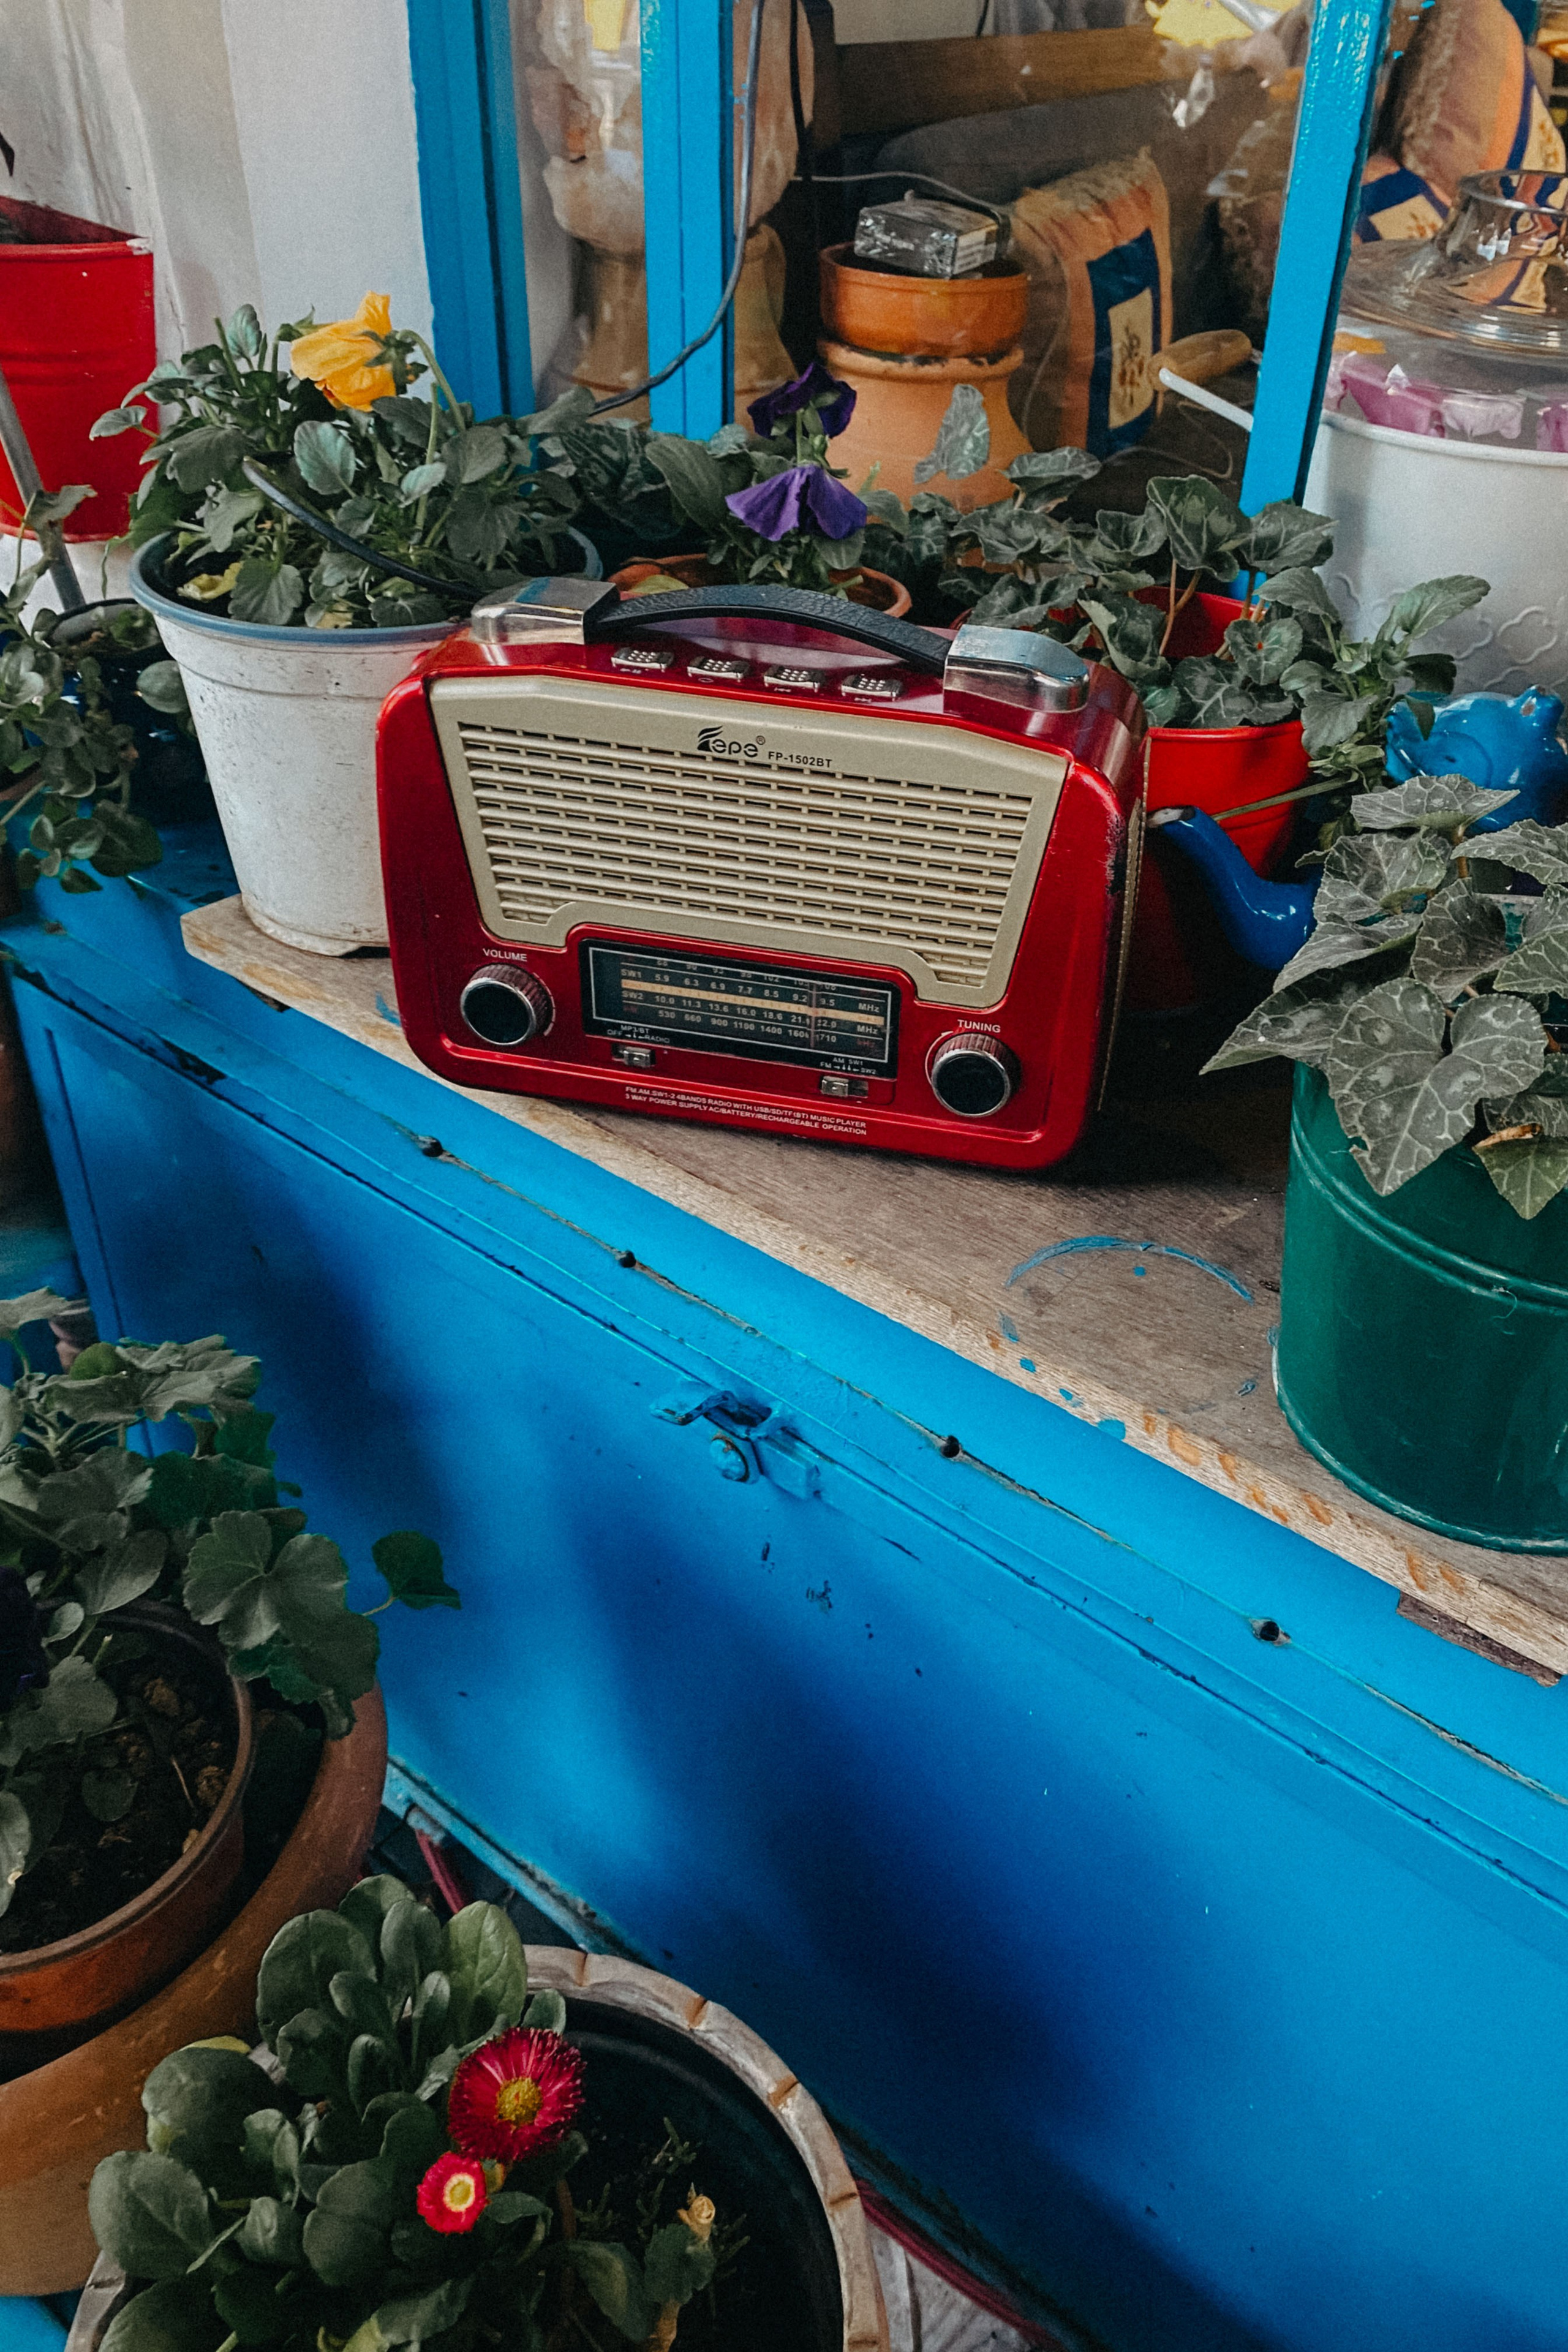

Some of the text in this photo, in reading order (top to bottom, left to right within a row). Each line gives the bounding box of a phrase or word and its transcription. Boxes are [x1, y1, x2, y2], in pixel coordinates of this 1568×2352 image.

[768, 752, 832, 767] FP-1502BT
[483, 948, 527, 962] VOLUME
[621, 968, 641, 978] SW1
[738, 986, 752, 994] 7.7
[764, 989, 779, 998] 8.5
[793, 993, 807, 1003] 9.2
[858, 1003, 880, 1012] MHz
[622, 990, 643, 1000] SW2
[655, 995, 675, 1004] 10.0
[682, 999, 701, 1008] 11.3
[709, 1003, 729, 1012] 13.6
[736, 1007, 756, 1017] 16.0
[857, 1025, 879, 1035] MHz
[620, 1025, 650, 1034] MP3/BT
[658, 1011, 676, 1019] 530
[711, 1018, 728, 1027] 900
[733, 1021, 755, 1031] 1100
[761, 1025, 782, 1035] 1400
[957, 1019, 1001, 1033] TUNING
[645, 1035, 671, 1044] RADIO
[649, 1098, 677, 1106] POWER
[678, 1102, 708, 1110] SUPPLY
[821, 1122, 867, 1135] OPERATION
[707, 1099, 732, 1107] RADIO
[810, 1114, 835, 1123] MUSIC
[836, 1118, 866, 1128] PLAYER
